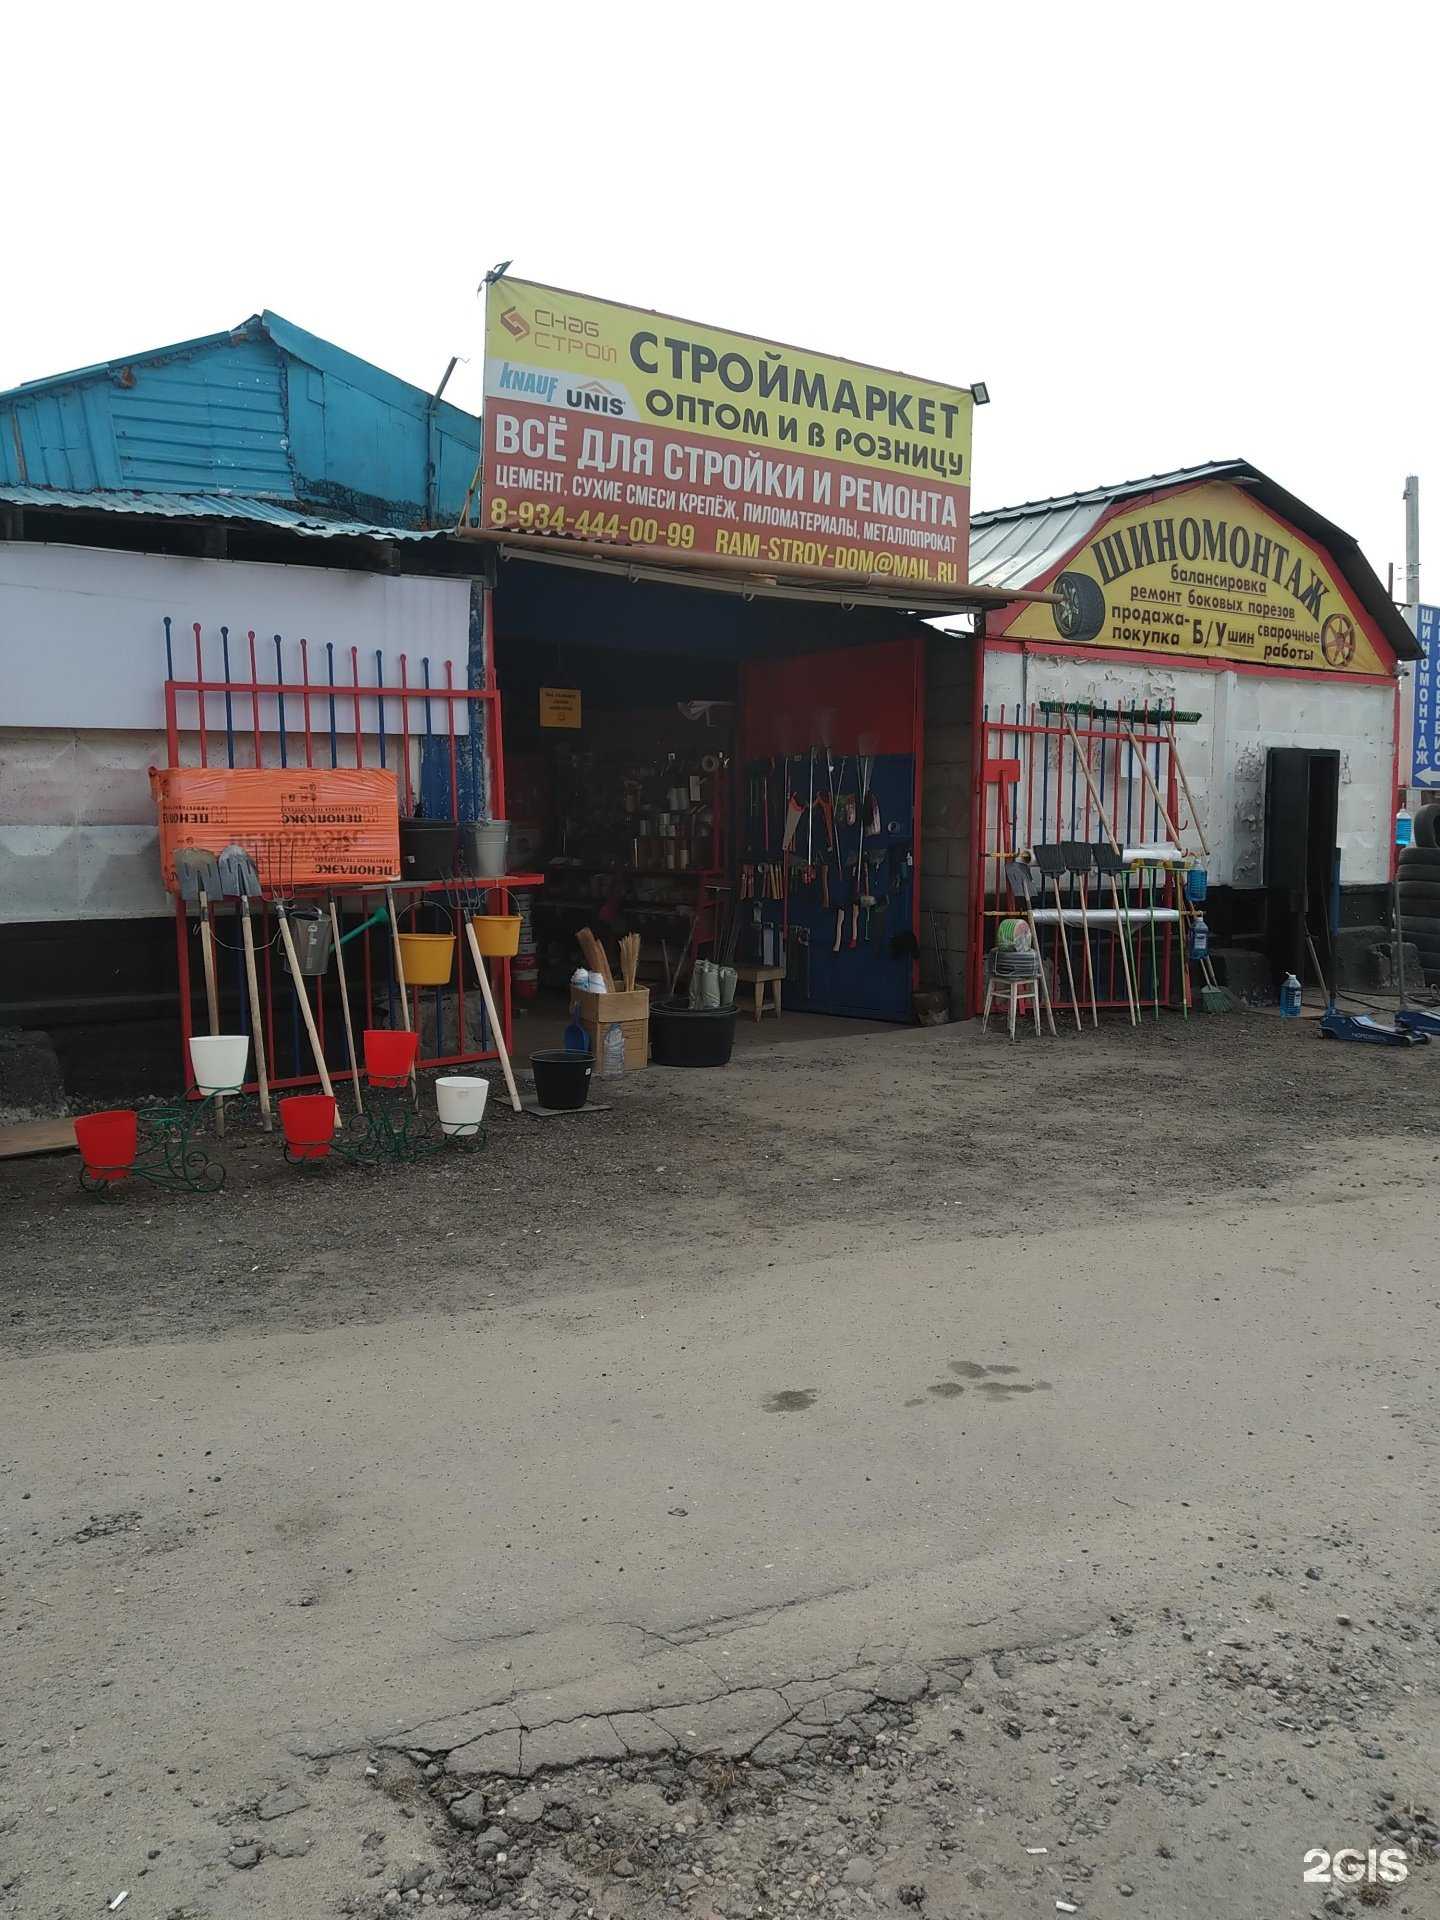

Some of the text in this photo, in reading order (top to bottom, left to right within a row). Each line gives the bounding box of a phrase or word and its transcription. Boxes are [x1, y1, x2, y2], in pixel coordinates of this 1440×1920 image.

[629, 331, 959, 439] СТРОЙМАРКЕТ
[566, 389, 625, 416] UNIS
[645, 389, 963, 477] ОПТОМ И В РОЗНИЦУ
[495, 414, 957, 529] ВСЁ ДЛЯ СТРОЙКИ И РЕМОНТА
[495, 464, 957, 553] ЦЕМЕНТ, СУХИЕ СМЕСИ КРЕПЁЖ, ПИЛОМАТЕРИАЛЫ, МЕТАЛЛОПРОКАТ
[490, 498, 957, 584] 8-934-444-00-99 RAM-STROY-DOM@MAIL.RU
[1090, 517, 1330, 623] ШИНОМОНТАЖ
[1170, 563, 1267, 593] балансировка
[1130, 585, 1295, 619] ремонт боковых порезов
[1111, 626, 1180, 647] покупка
[1192, 618, 1255, 649] Б/У шин
[1257, 623, 1321, 645] сварочные
[1263, 644, 1314, 662] работы
[1415, 608, 1434, 765] ШИНОМОНТАЖ
[281, 813, 363, 824] ПЕНОПЛЭКС
[314, 863, 393, 876] ПЕНОПЛЭКС
